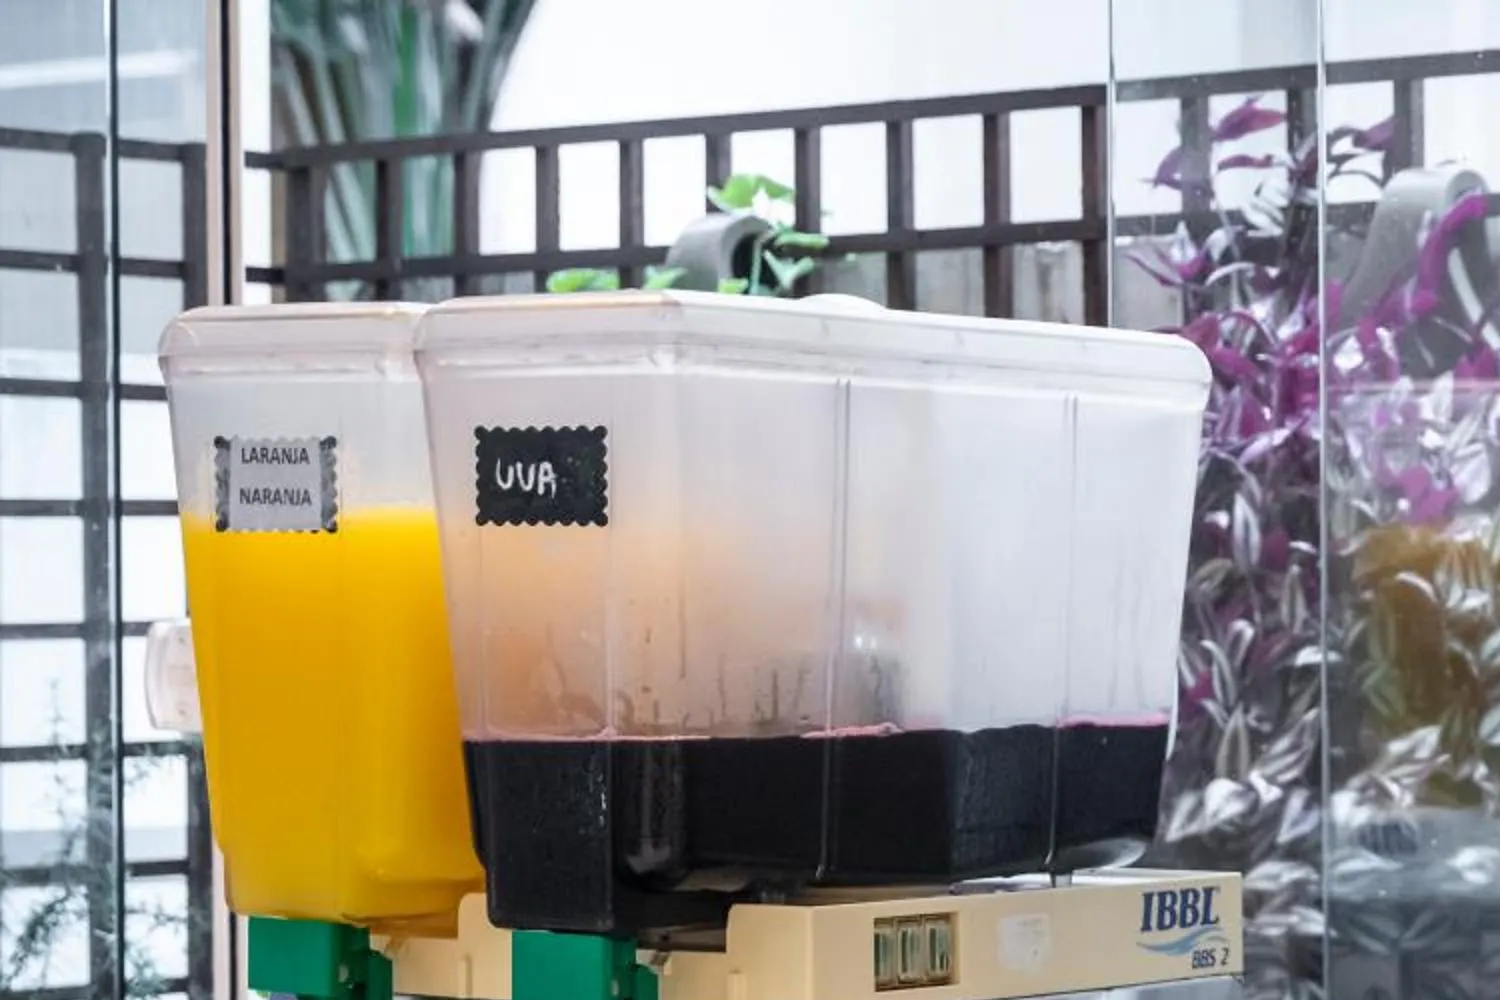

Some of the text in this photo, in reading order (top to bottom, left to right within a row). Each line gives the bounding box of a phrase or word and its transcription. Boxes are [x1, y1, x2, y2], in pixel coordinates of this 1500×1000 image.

[240, 447, 311, 465] LARANJA
[495, 457, 558, 499] UVA
[239, 487, 312, 506] NARANJA
[1140, 886, 1220, 933] IBBL
[1219, 947, 1230, 966] 2
